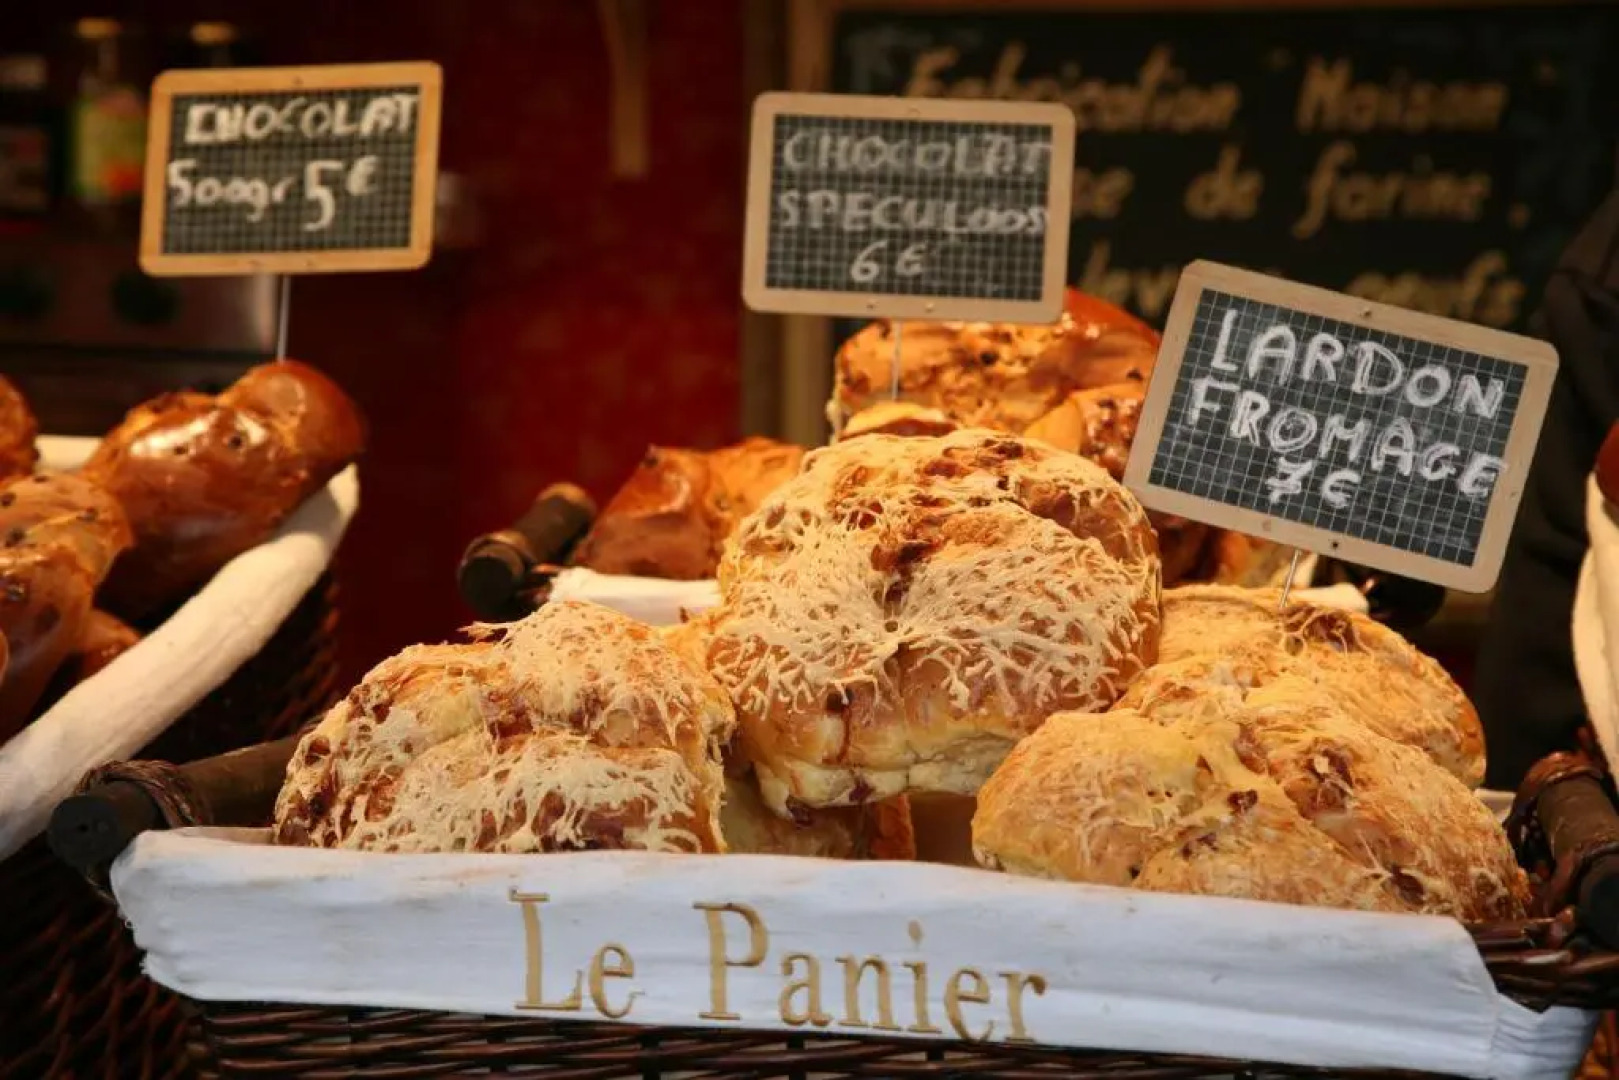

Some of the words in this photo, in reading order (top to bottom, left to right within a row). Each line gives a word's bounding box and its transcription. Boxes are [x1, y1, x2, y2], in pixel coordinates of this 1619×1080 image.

[783, 130, 1053, 177] CHOCOLAT
[1210, 309, 1505, 419] LARDON
[1188, 375, 1506, 497] FROMAGE
[509, 887, 646, 1019] Le
[692, 900, 1048, 1044] Panier
